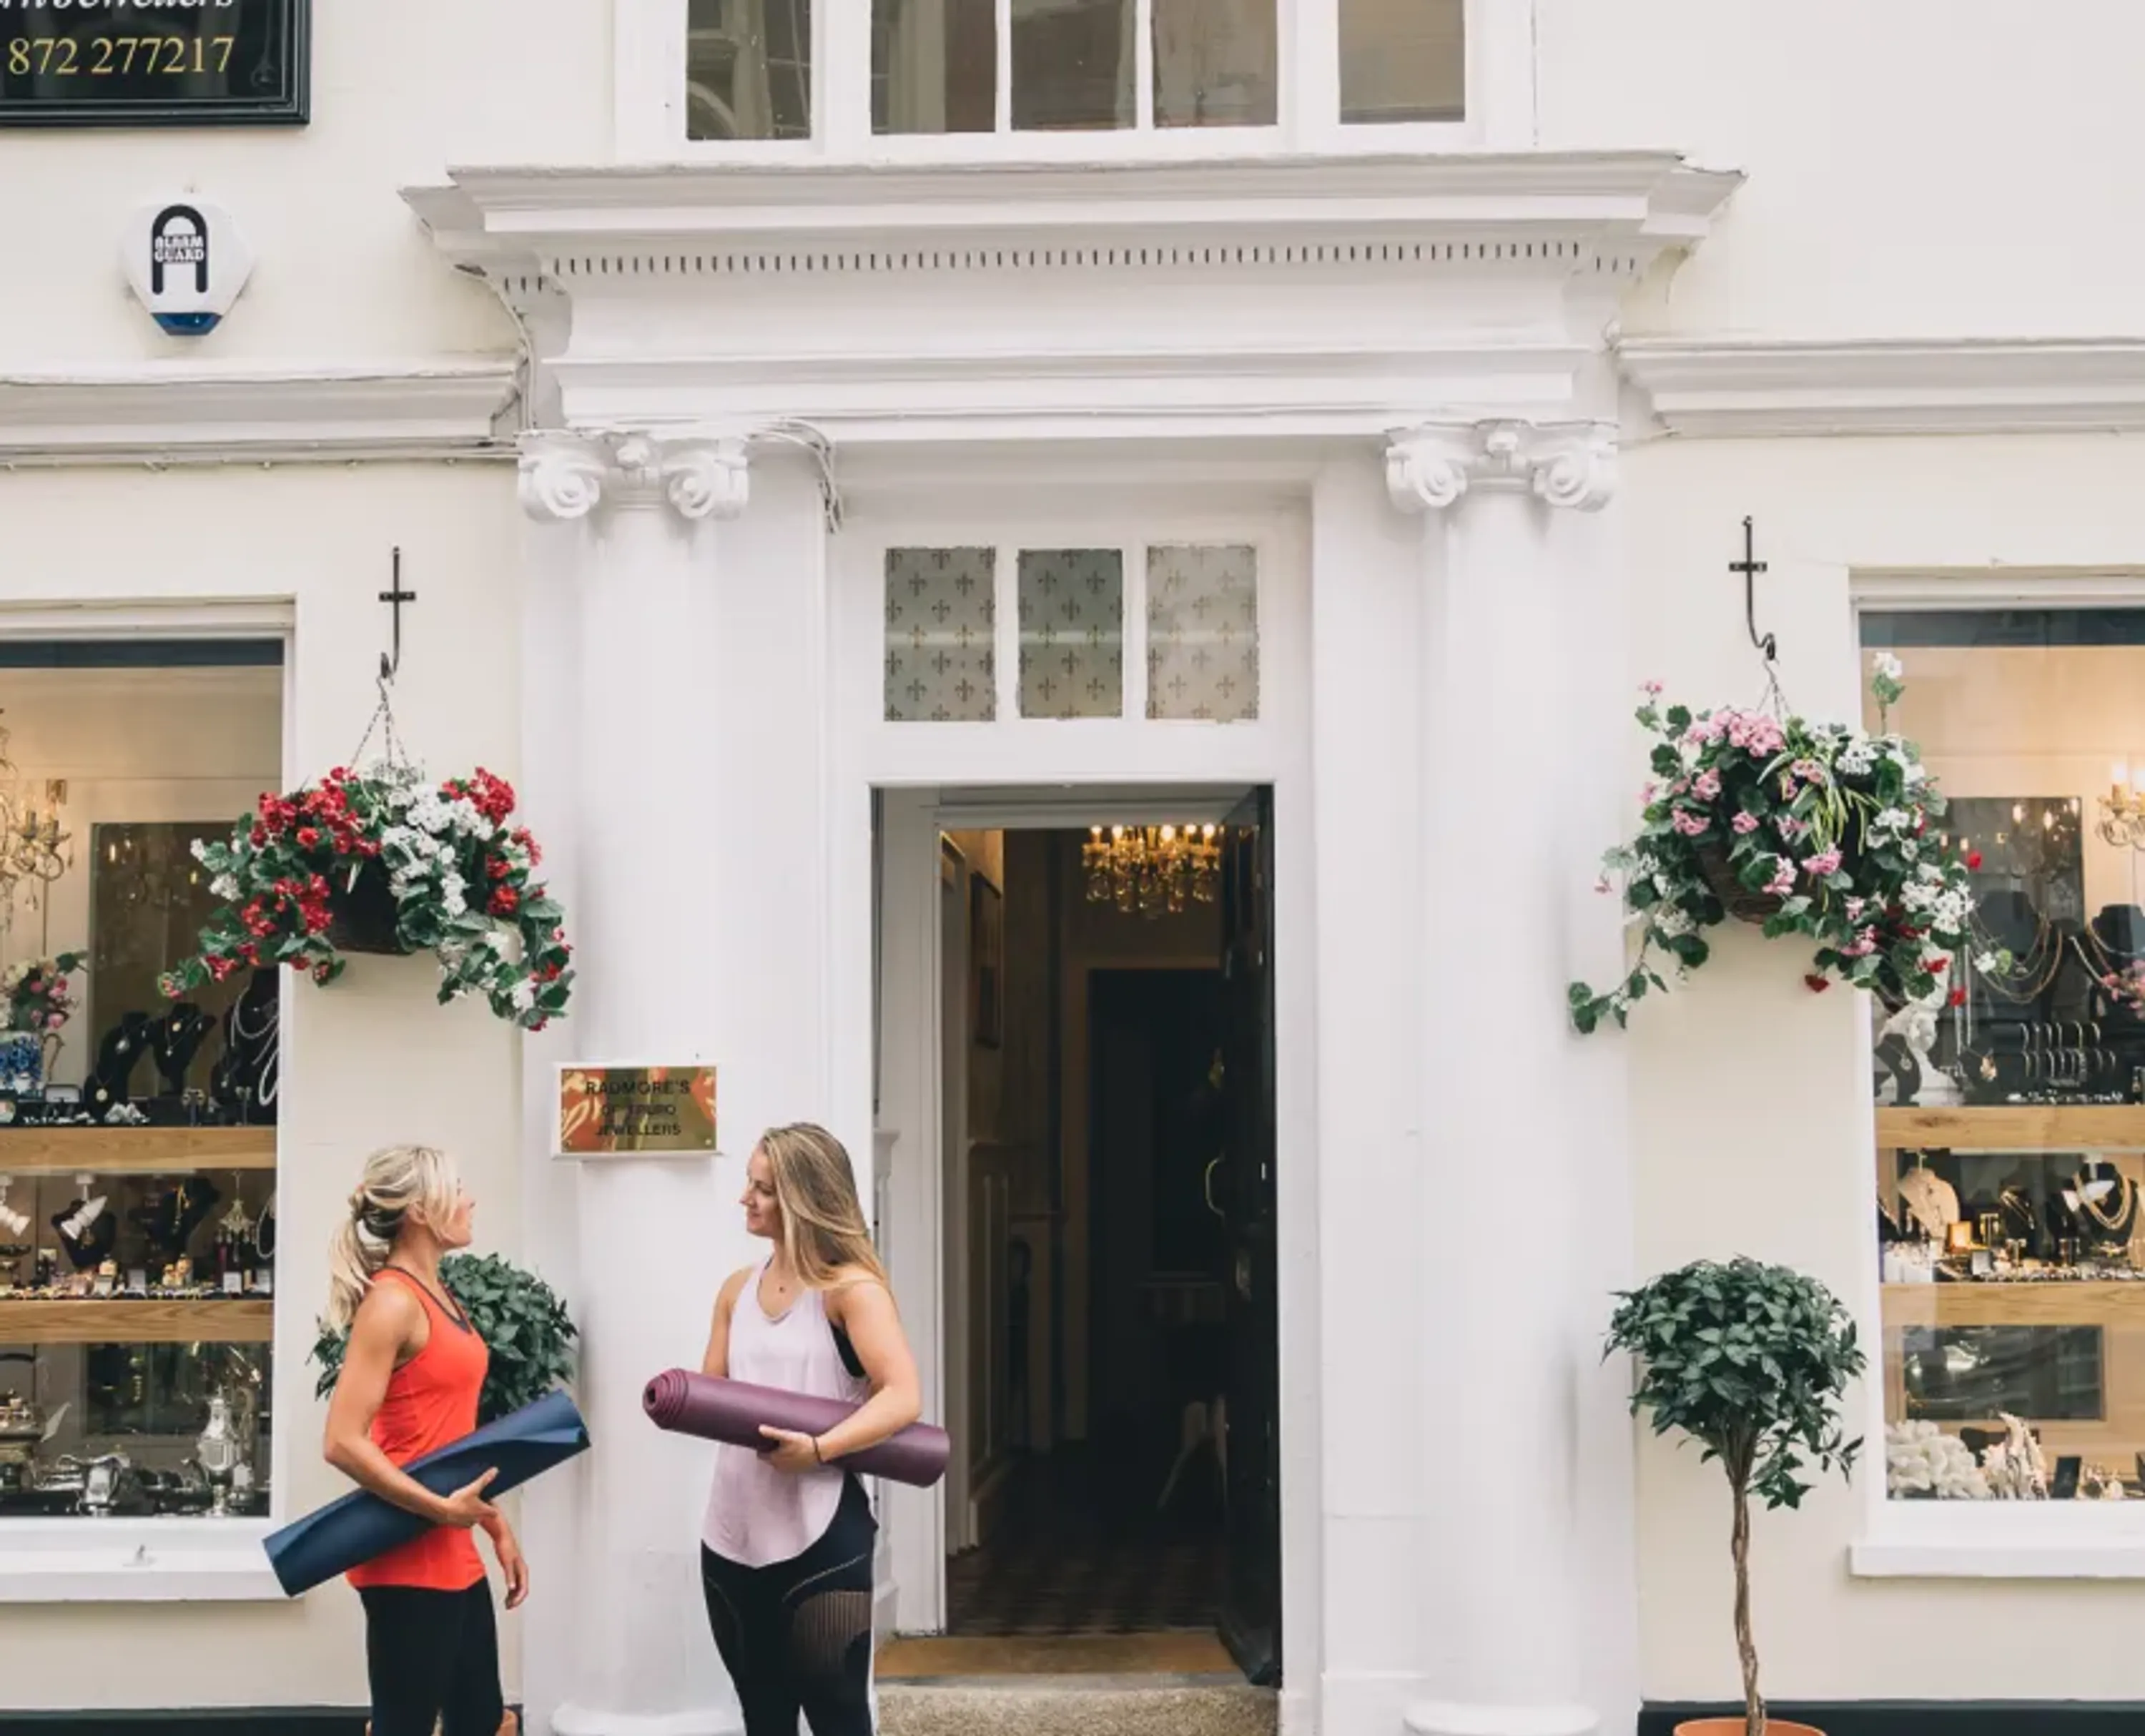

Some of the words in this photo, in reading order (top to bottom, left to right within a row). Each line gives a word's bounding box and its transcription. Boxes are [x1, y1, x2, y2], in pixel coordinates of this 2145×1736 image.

[9, 37, 79, 75] 872
[91, 36, 235, 75] 277217
[585, 1079, 690, 1095] RADMORE'S
